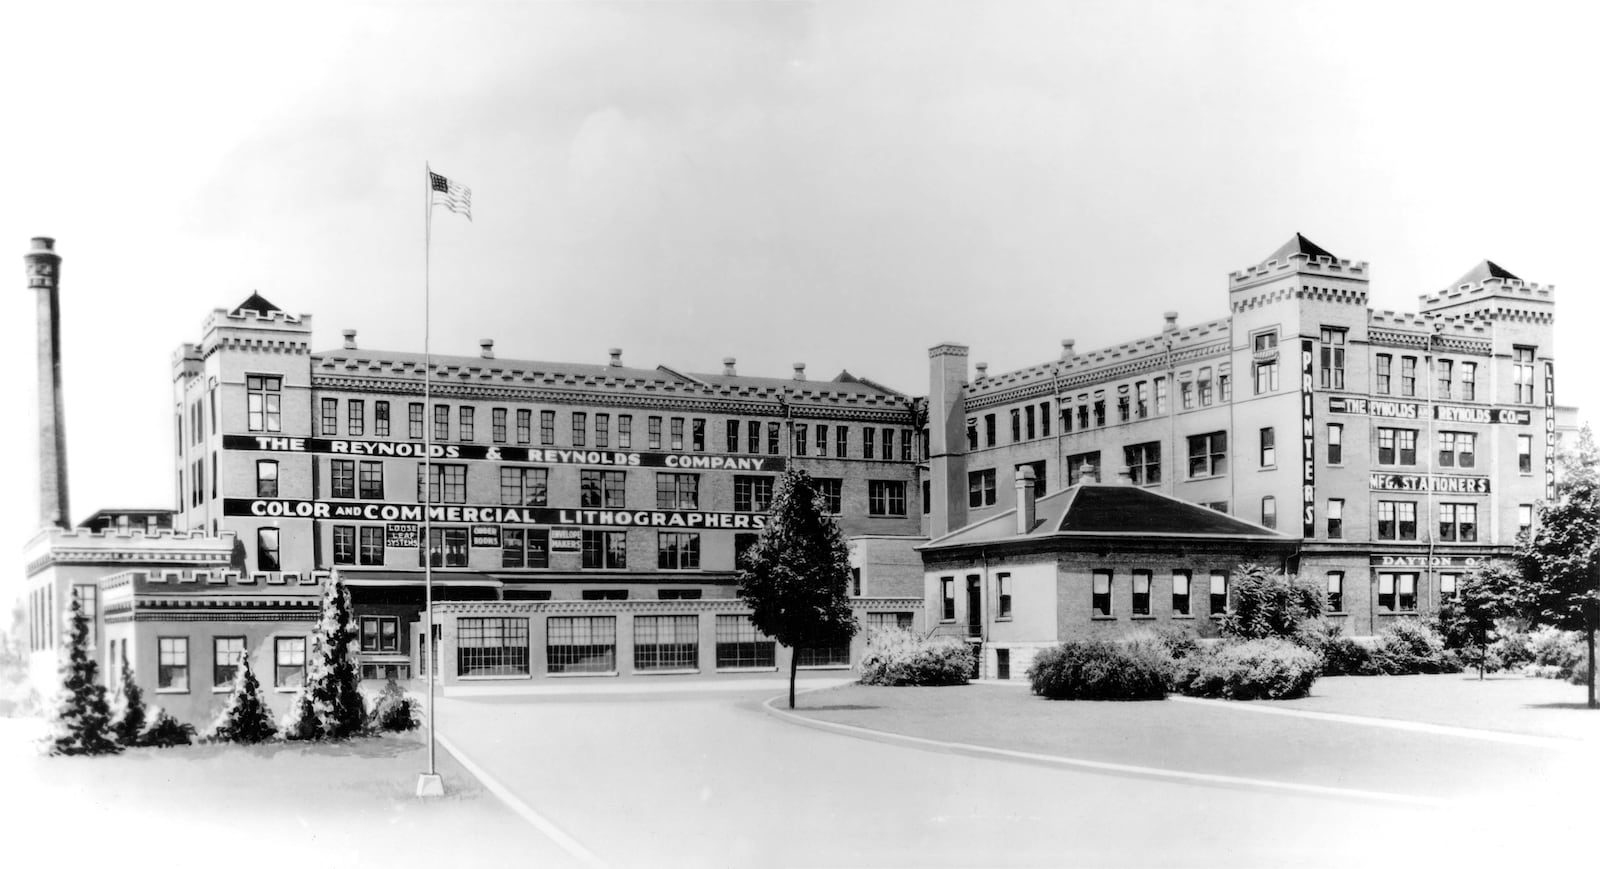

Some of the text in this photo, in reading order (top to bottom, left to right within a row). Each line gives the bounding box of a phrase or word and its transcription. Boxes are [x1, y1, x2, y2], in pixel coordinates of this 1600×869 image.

[1344, 398, 1367, 415] THE
[1370, 401, 1416, 419] EYNOLDS
[1438, 405, 1492, 423] REYNOLDS
[1302, 350, 1314, 524] PRINTERS
[256, 437, 764, 471] THE REYNOLDS & REYNOLDS COMPANY
[1369, 473, 1487, 493] MFG. STATIONERS
[251, 500, 766, 529] COLOR AND COMMERCIAL LITHOGRAPHERS
[388, 524, 417, 533] LOOSE
[551, 528, 581, 539] ENVELOPE
[386, 539, 418, 548] SYSTEMS
[473, 536, 499, 546] BOOKS
[551, 539, 581, 549] MAKERS
[1382, 556, 1452, 566] DAYTON
